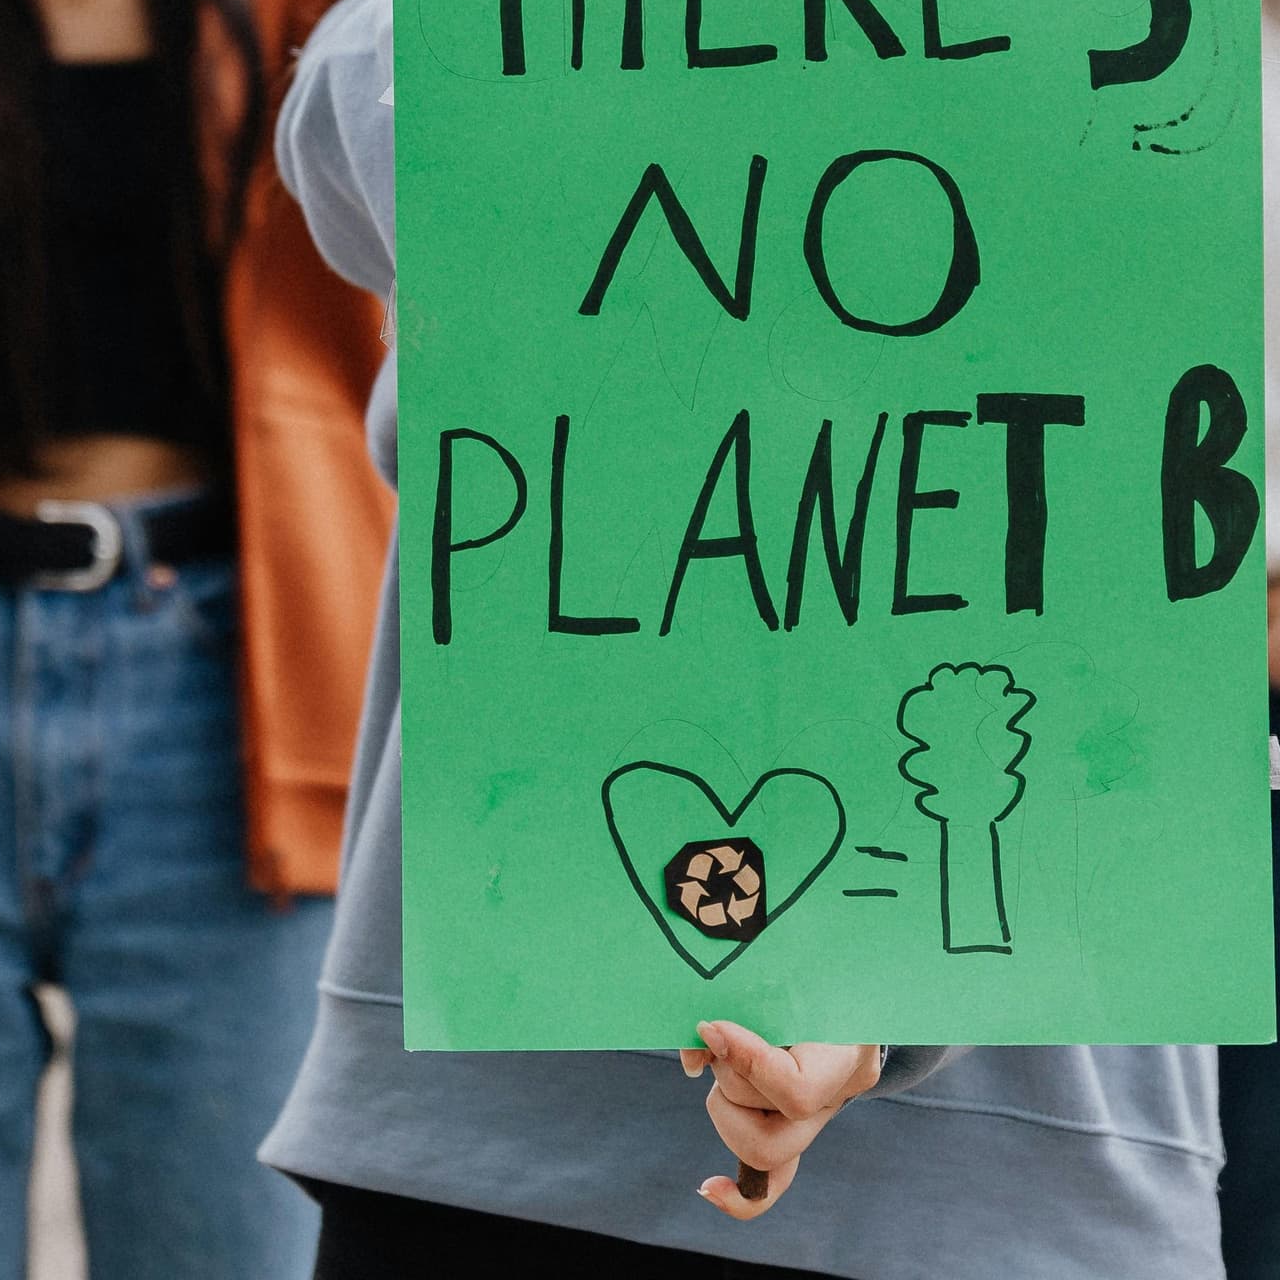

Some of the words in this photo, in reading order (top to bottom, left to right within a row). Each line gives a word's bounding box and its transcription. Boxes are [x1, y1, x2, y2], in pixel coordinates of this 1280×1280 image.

[578, 148, 982, 337] NO
[431, 393, 1086, 646] PLANET
[1160, 363, 1262, 603] B
